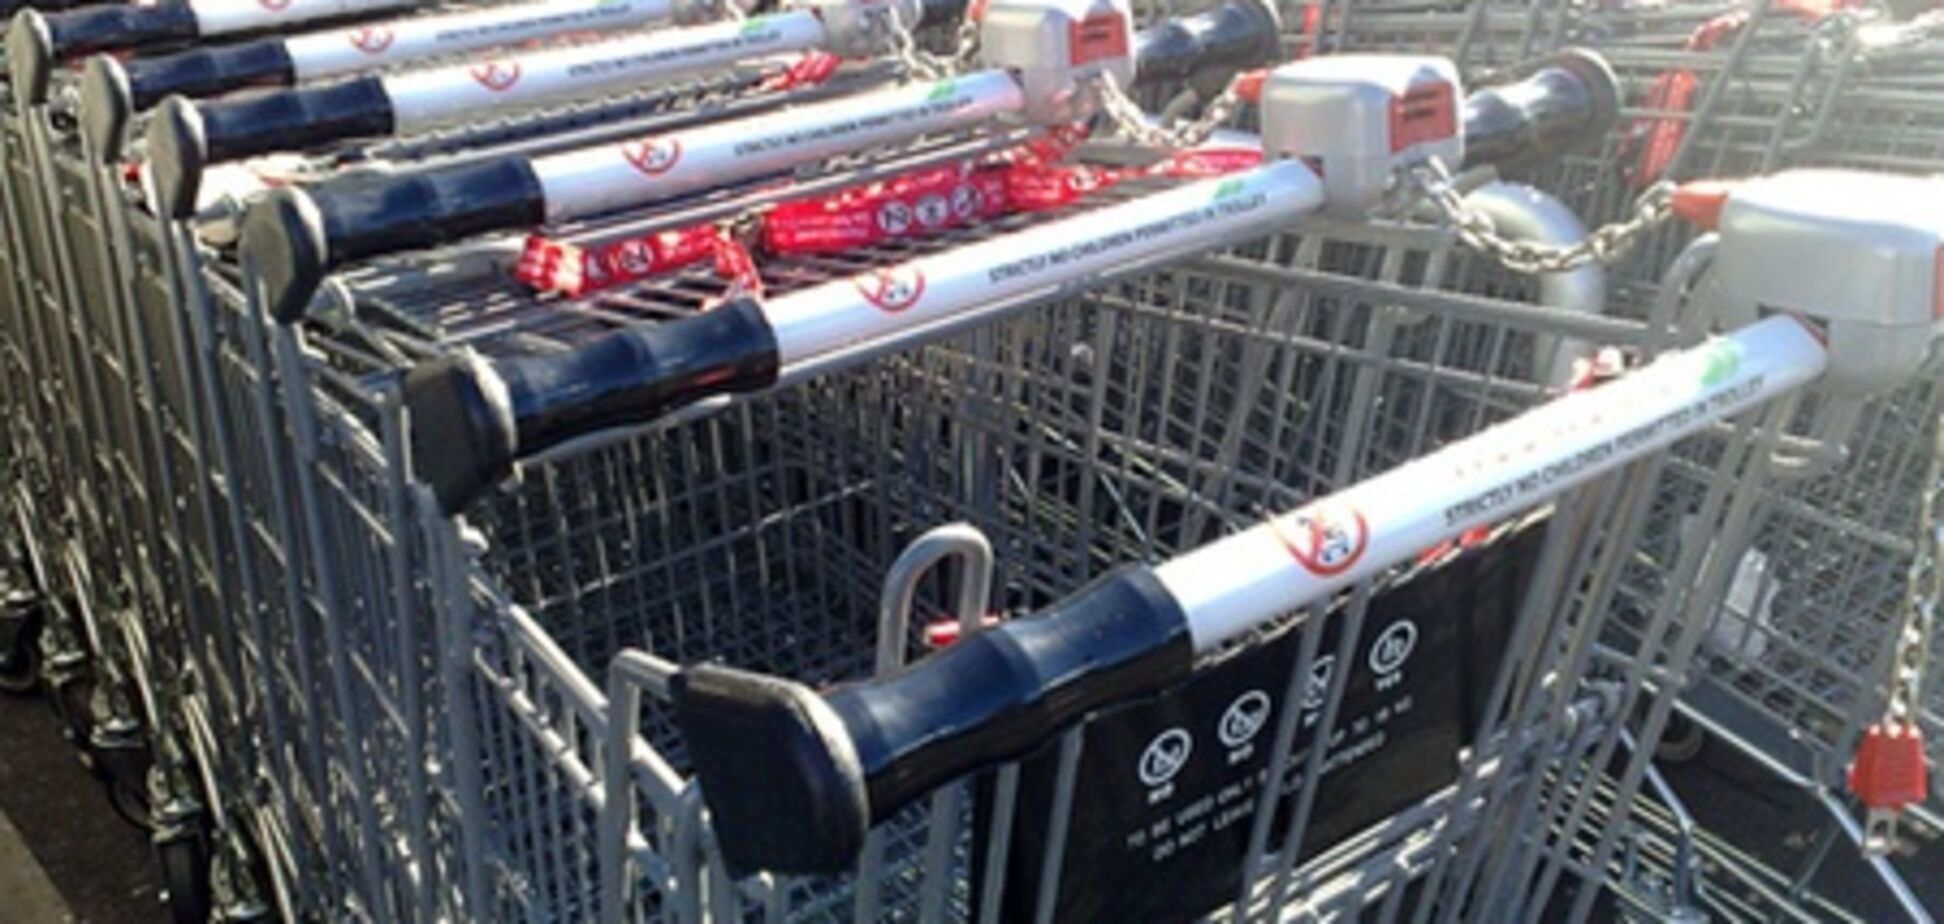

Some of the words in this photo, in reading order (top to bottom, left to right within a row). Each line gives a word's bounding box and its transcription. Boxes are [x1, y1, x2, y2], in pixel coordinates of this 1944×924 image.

[989, 254, 1045, 282] STRICTLY
[1051, 247, 1069, 264] NO
[1071, 231, 1133, 259] CHILDREN
[1135, 212, 1198, 240] PERMITTED
[1217, 193, 1266, 214] TROLLEY
[1445, 483, 1512, 526] STRICTLY
[1517, 471, 1539, 493] NO
[1542, 441, 1612, 484] CHILDREN
[1615, 407, 1690, 449] PERMITTED
[1695, 399, 1708, 415] IN
[1710, 375, 1764, 407] TROLLEY
